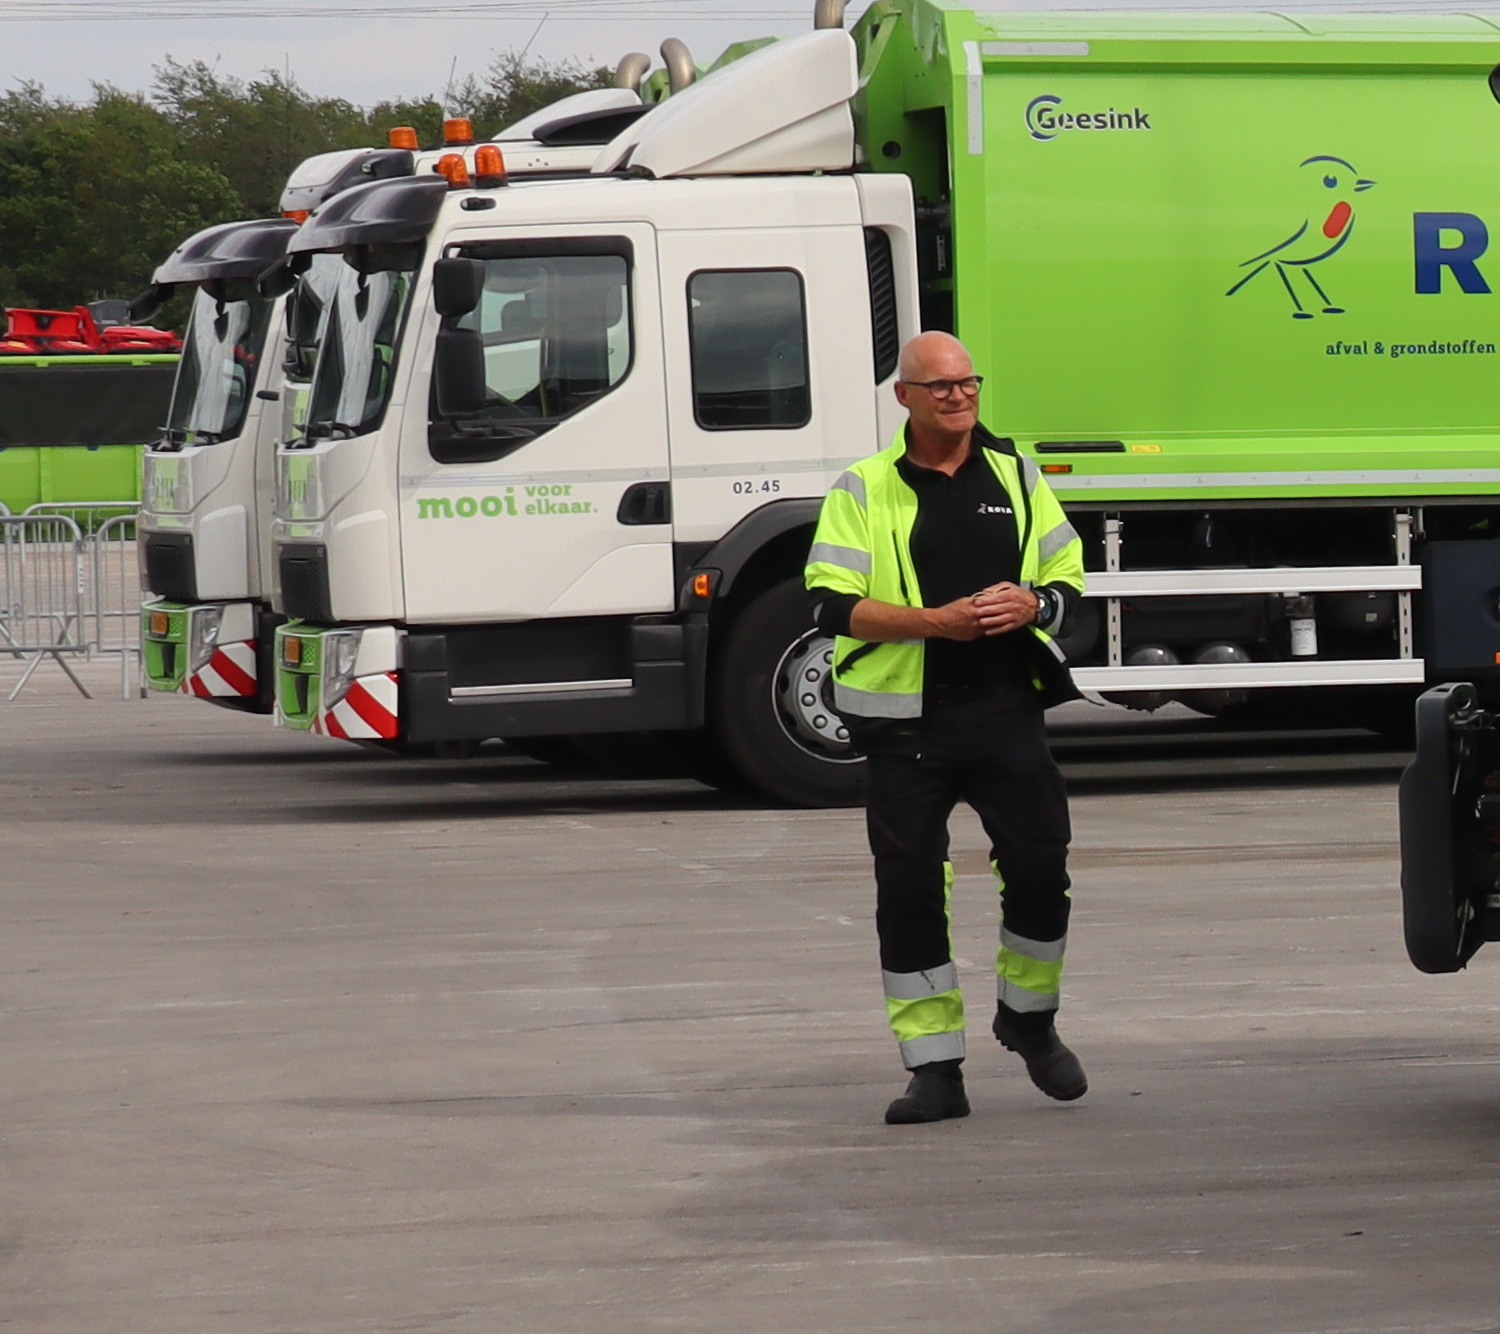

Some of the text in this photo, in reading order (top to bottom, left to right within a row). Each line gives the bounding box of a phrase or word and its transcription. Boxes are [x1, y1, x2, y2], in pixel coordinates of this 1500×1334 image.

[1036, 106, 1152, 130] Geesink
[1325, 340, 1496, 358] afval & grondstoffen
[525, 484, 573, 498] voor
[732, 480, 781, 495] 02.45
[416, 487, 518, 519] mooi
[525, 498, 599, 516] elkaar.
